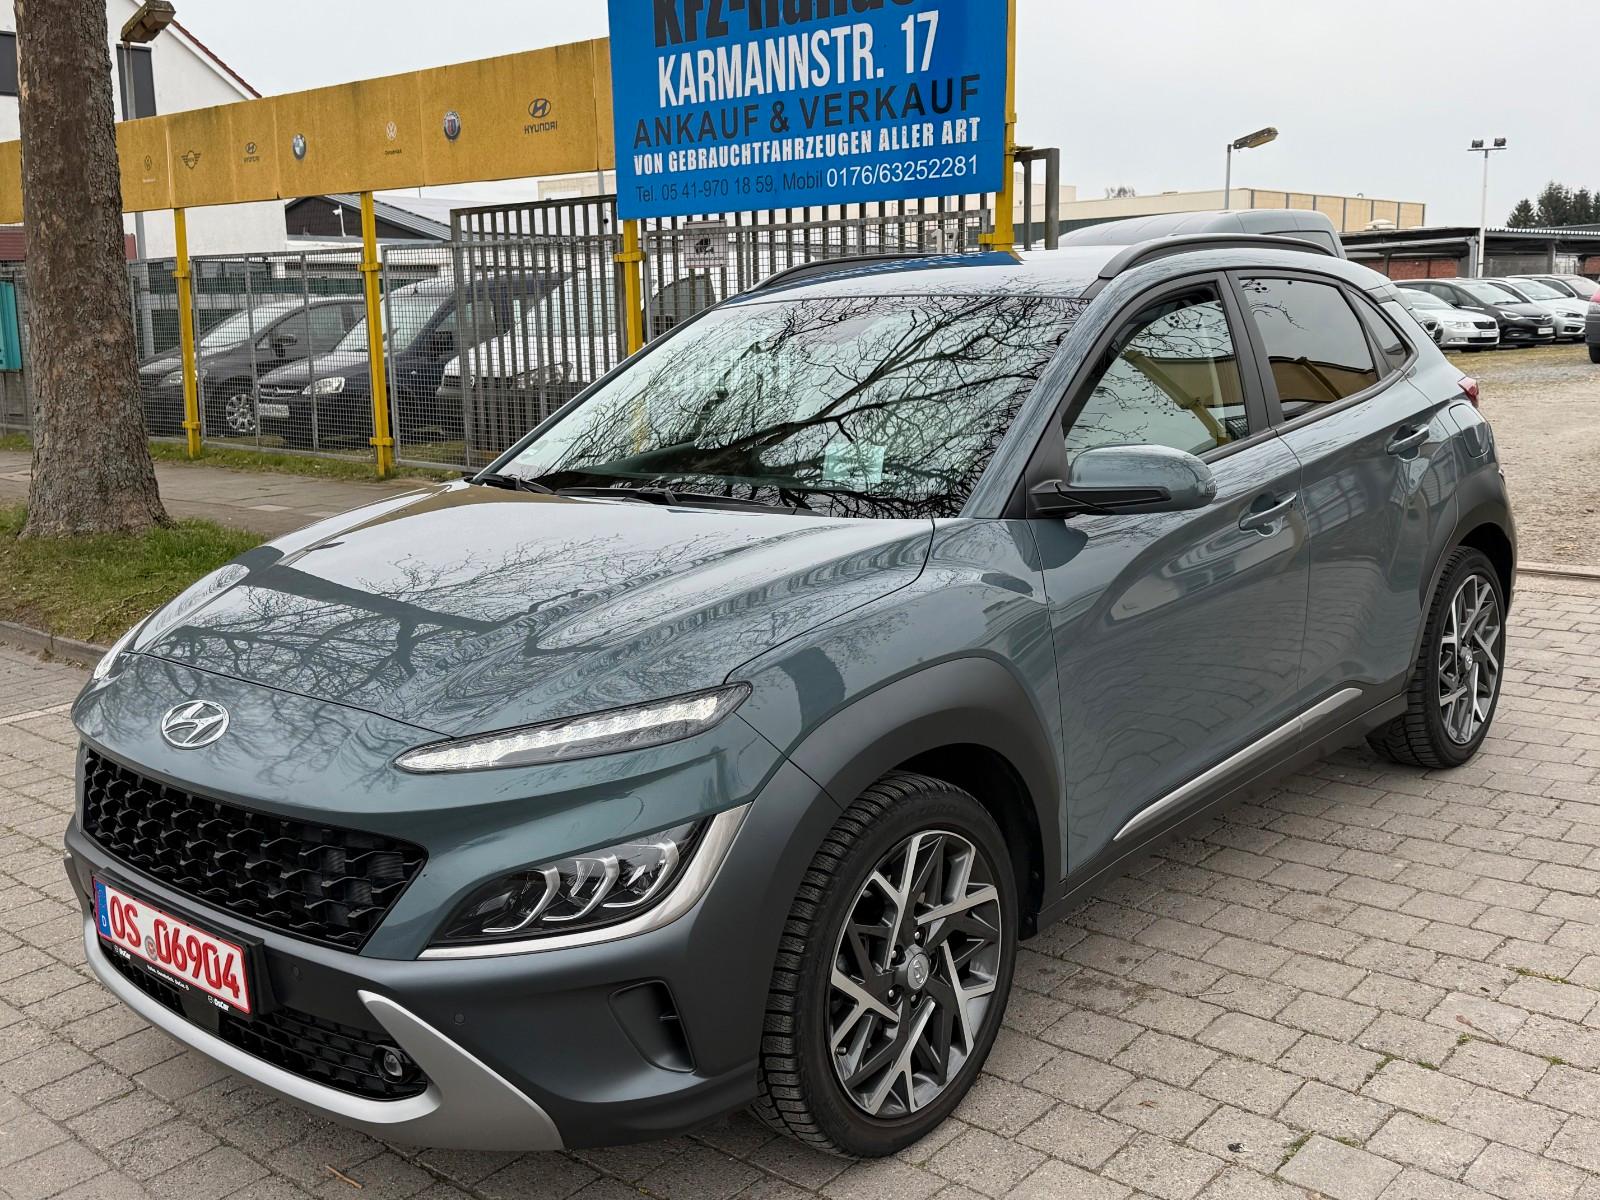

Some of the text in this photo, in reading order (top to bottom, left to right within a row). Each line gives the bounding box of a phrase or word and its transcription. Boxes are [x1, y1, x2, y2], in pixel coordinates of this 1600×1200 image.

[657, 9, 939, 108] KARMANNSTR. 17
[523, 120, 558, 135] HYUNDAI
[633, 74, 981, 149] ANKAUF & VERKAUF
[633, 116, 981, 176] VON GEBRAUCHTFAHRZEUGEN ALLER ART
[635, 154, 978, 203] Tel. 05 41-970 18 59, Mobil 0176/63252281
[931, 228, 960, 253] 17
[110, 895, 142, 948] OS
[153, 918, 240, 999] 06904
